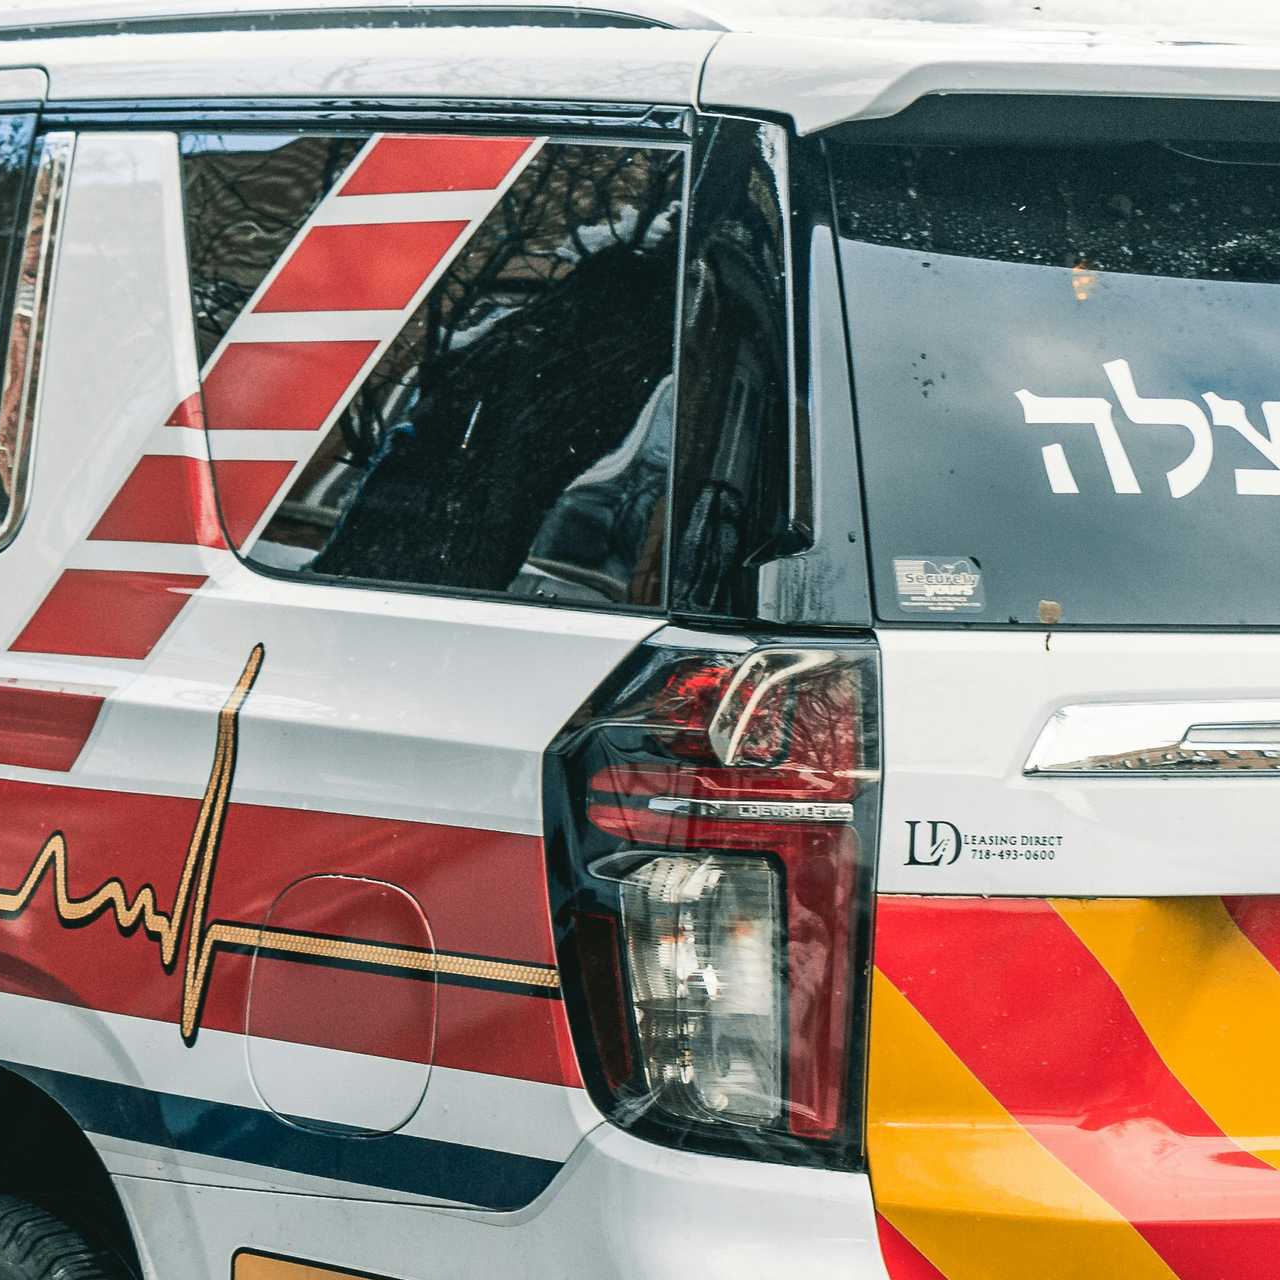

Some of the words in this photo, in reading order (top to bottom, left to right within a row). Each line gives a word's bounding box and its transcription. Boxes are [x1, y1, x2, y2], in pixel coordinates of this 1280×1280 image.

[964, 834, 1017, 846] LEASING
[1021, 835, 1063, 846] DIRECT
[971, 849, 1055, 861] 718-493-0600
